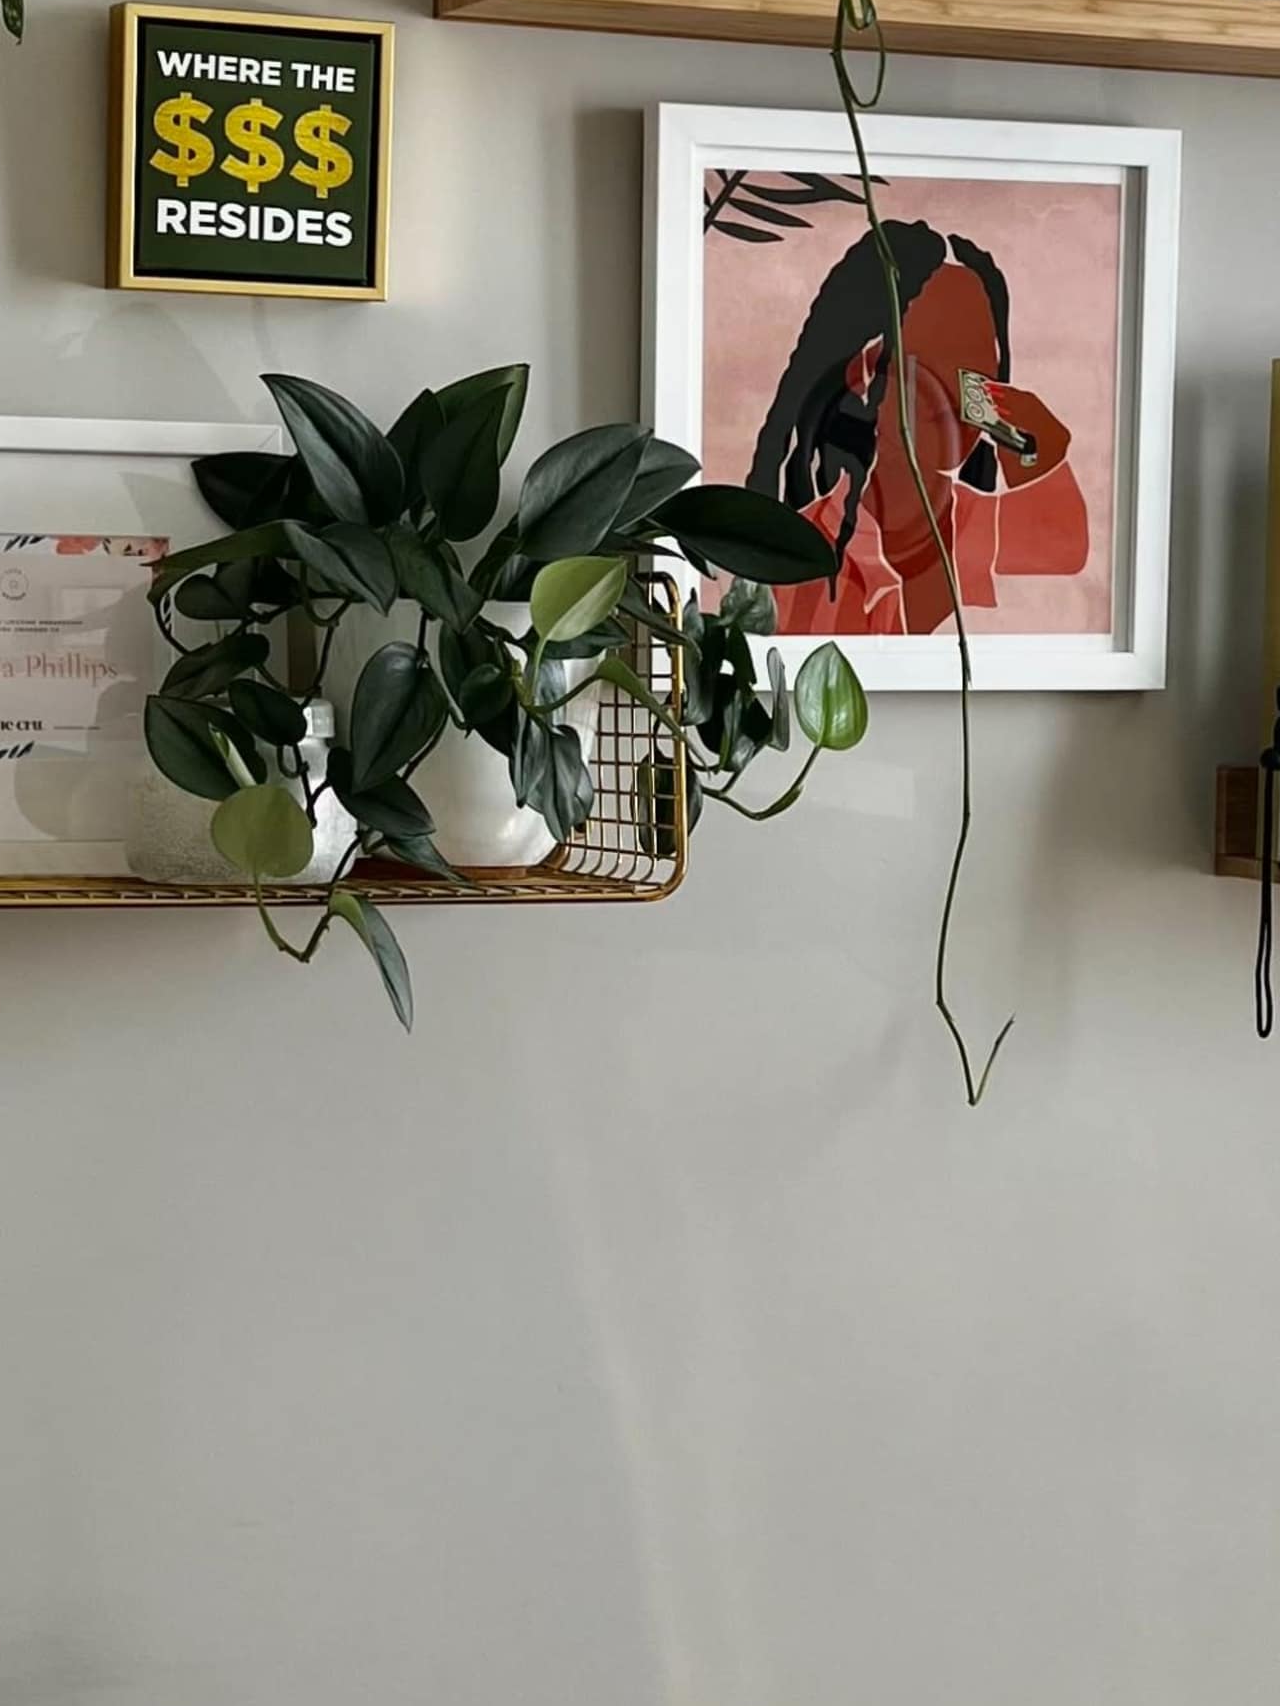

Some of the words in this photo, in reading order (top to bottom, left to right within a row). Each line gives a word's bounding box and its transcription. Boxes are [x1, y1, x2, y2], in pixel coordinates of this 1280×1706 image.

[157, 50, 282, 86] WHERE
[291, 63, 356, 92] THE
[156, 198, 352, 247] RESIDES
[26, 651, 118, 687] Phillips
[17, 719, 43, 731] cru
